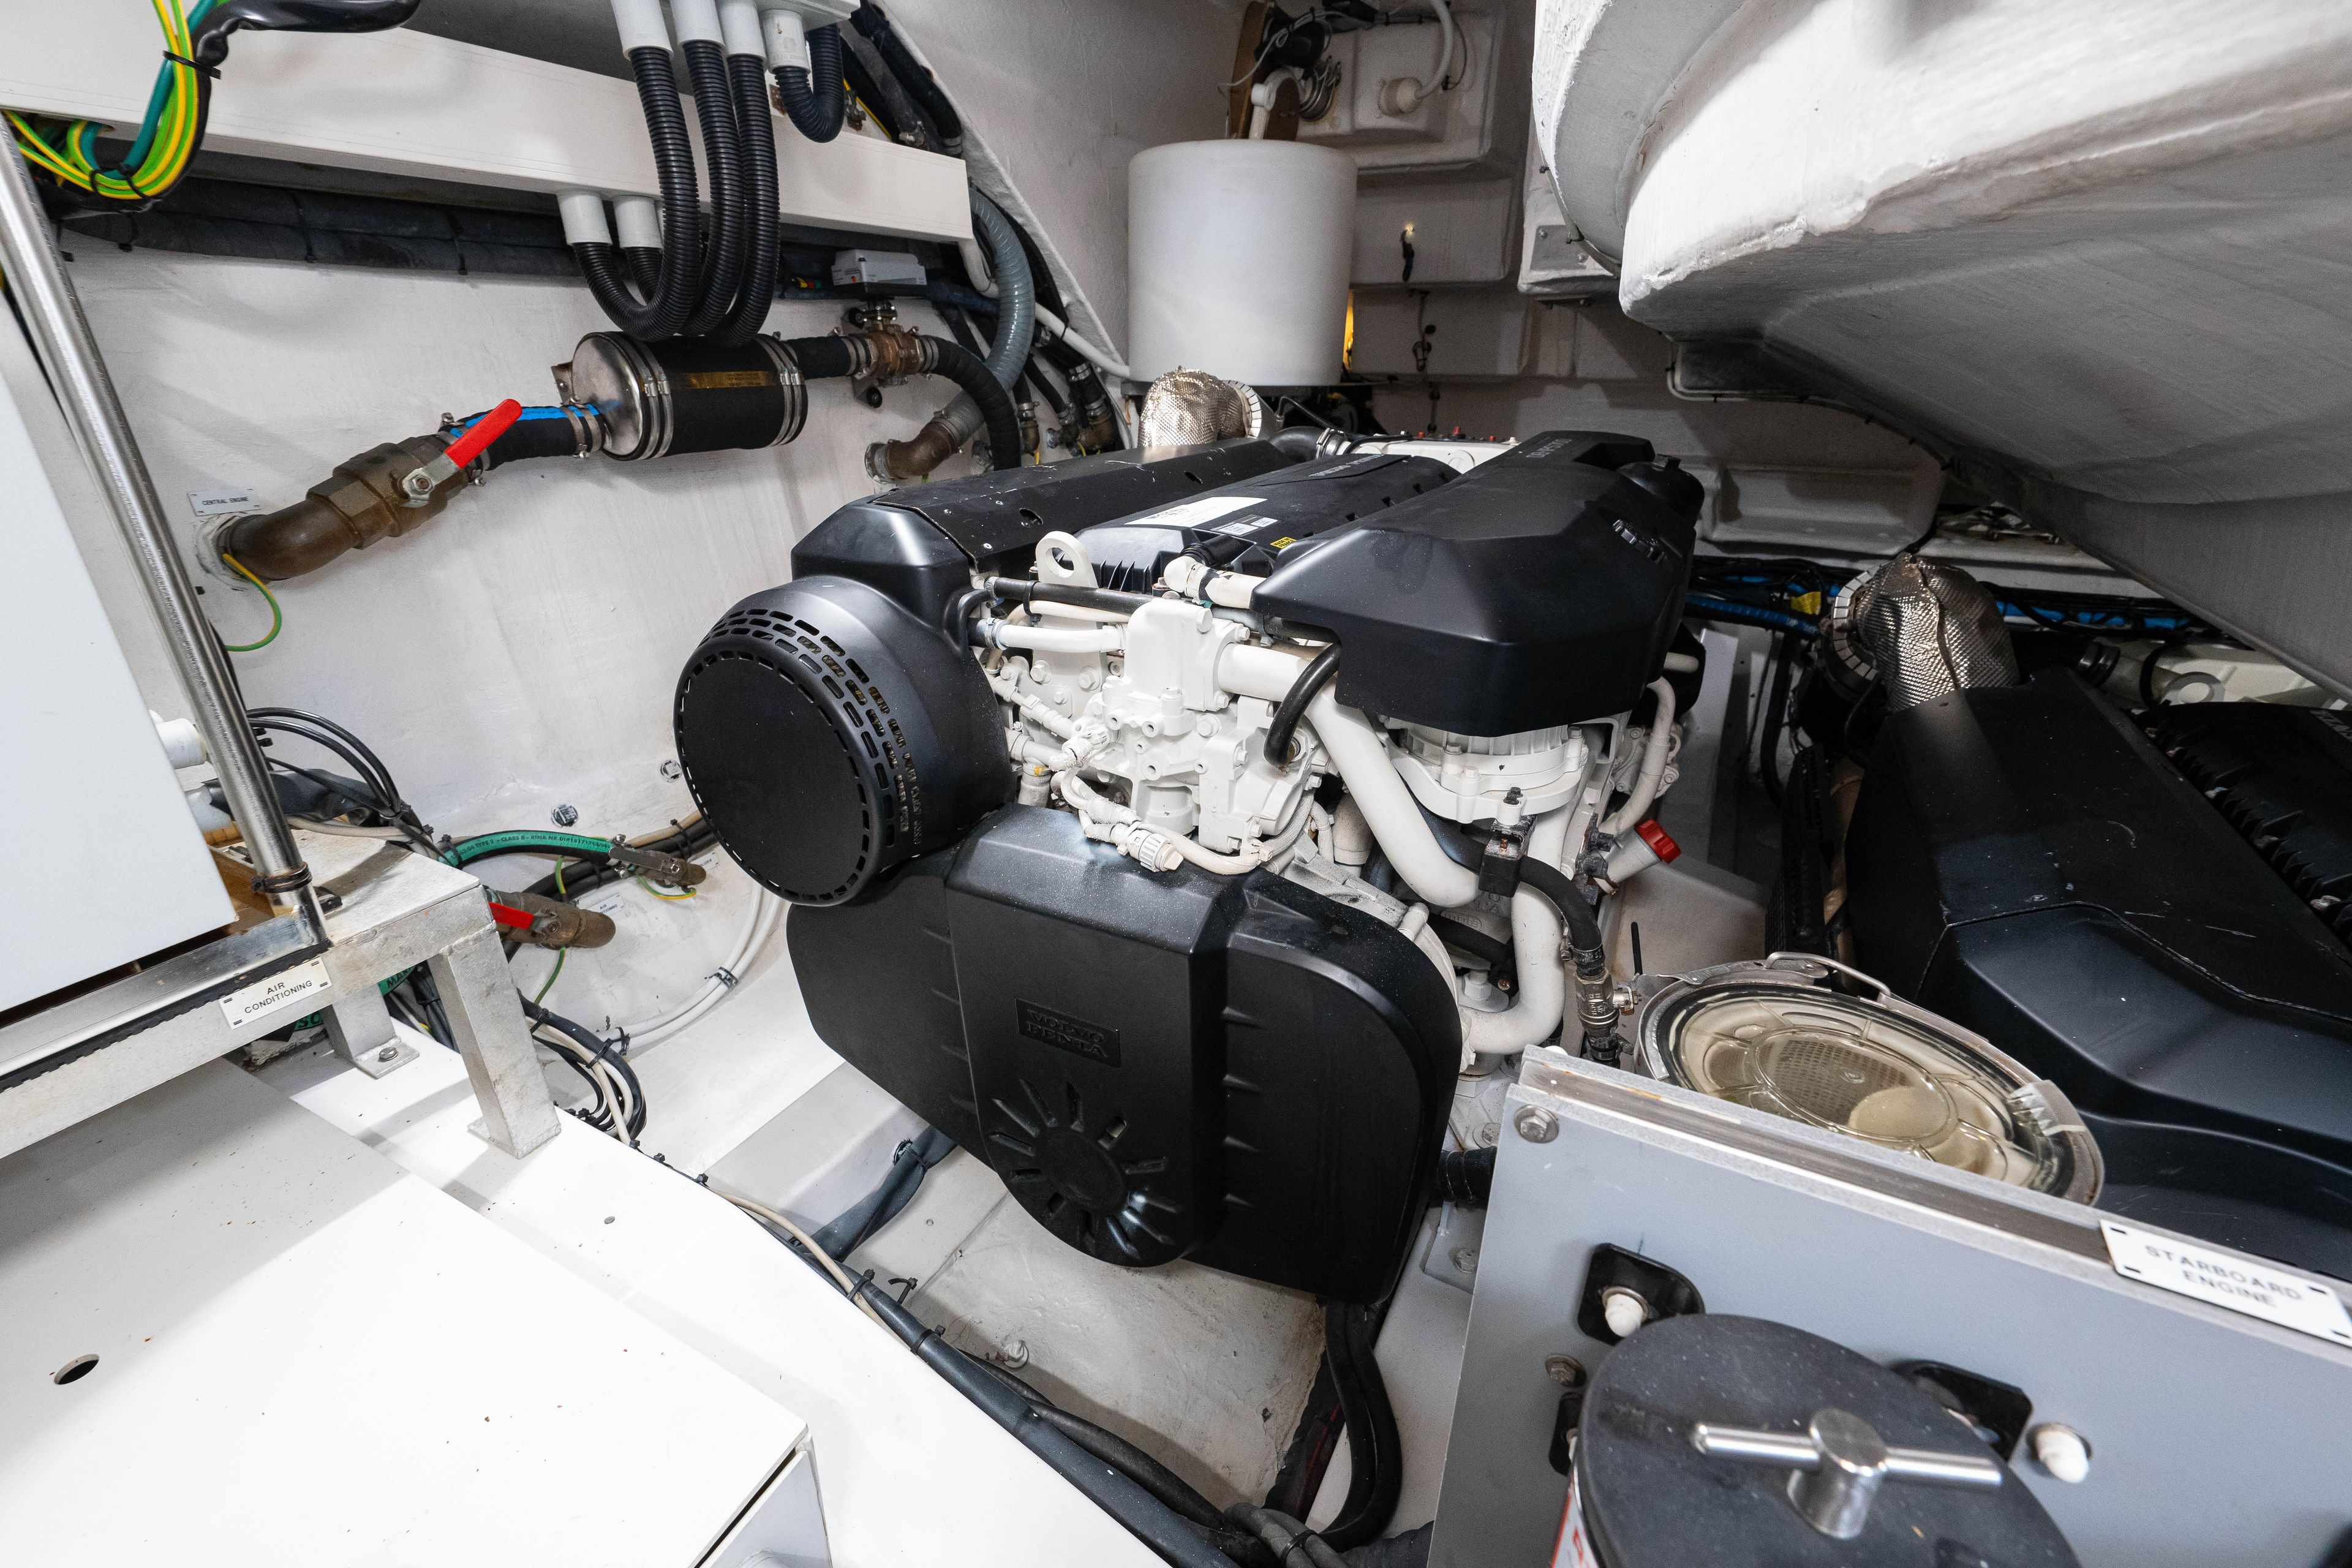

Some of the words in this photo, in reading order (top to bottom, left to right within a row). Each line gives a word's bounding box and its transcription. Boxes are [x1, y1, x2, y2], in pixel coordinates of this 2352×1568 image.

[244, 980, 312, 1014] CONDITIONING
[267, 982, 285, 995] AIR
[1026, 1021, 1108, 1058] PENTA
[1027, 1009, 1104, 1042] VOLVO
[2144, 1245, 2302, 1300] STARBOARD
[2182, 1270, 2277, 1308] ENGINE
